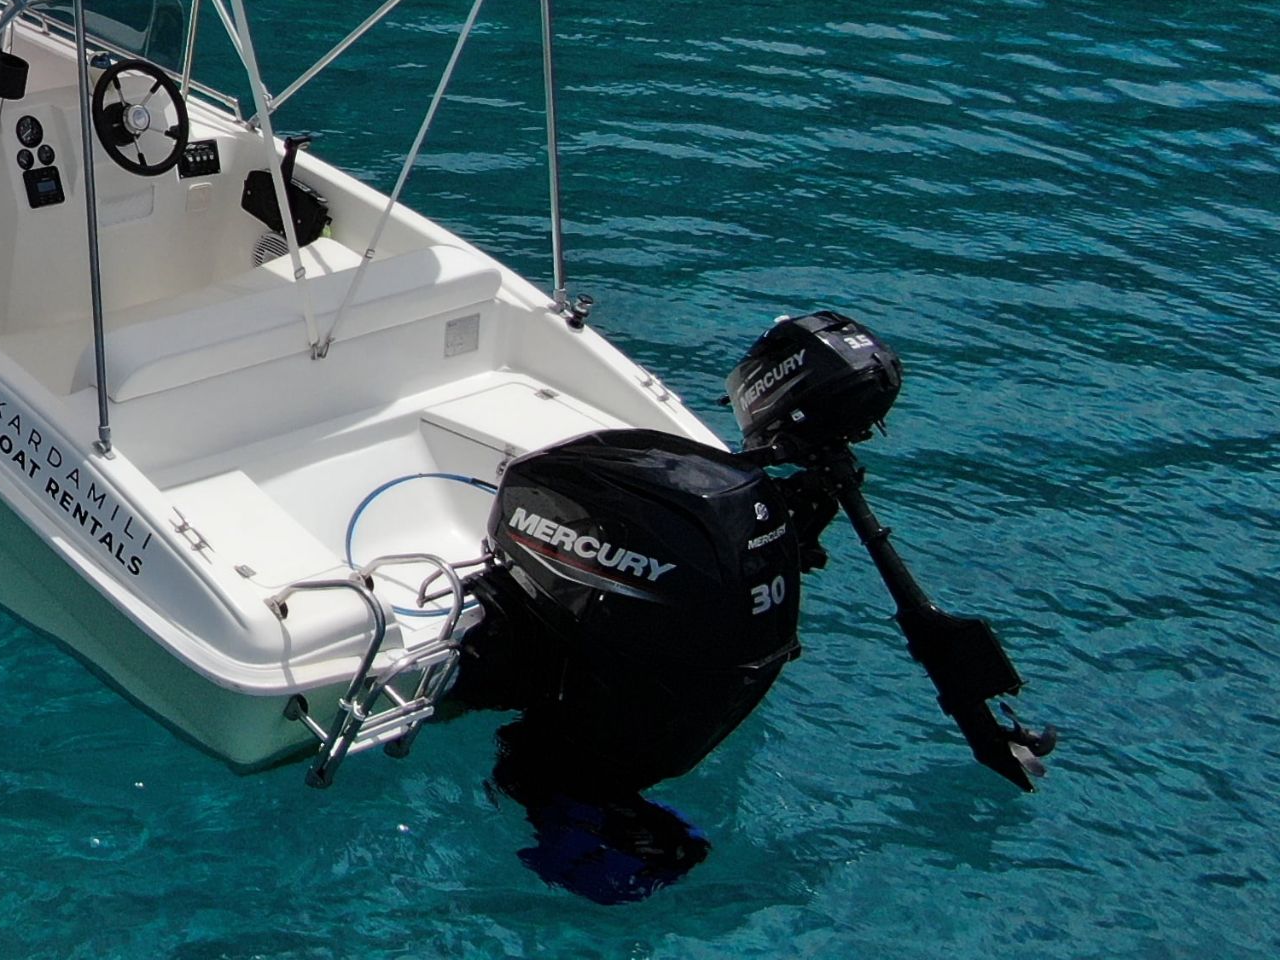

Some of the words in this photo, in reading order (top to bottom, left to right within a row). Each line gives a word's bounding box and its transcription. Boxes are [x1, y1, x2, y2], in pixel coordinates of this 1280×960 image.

[740, 348, 806, 411] MERCURY
[45, 477, 143, 576] RENTALS
[508, 506, 677, 582] MERCURY
[747, 524, 787, 549] MERCURY
[751, 575, 785, 615] 30
